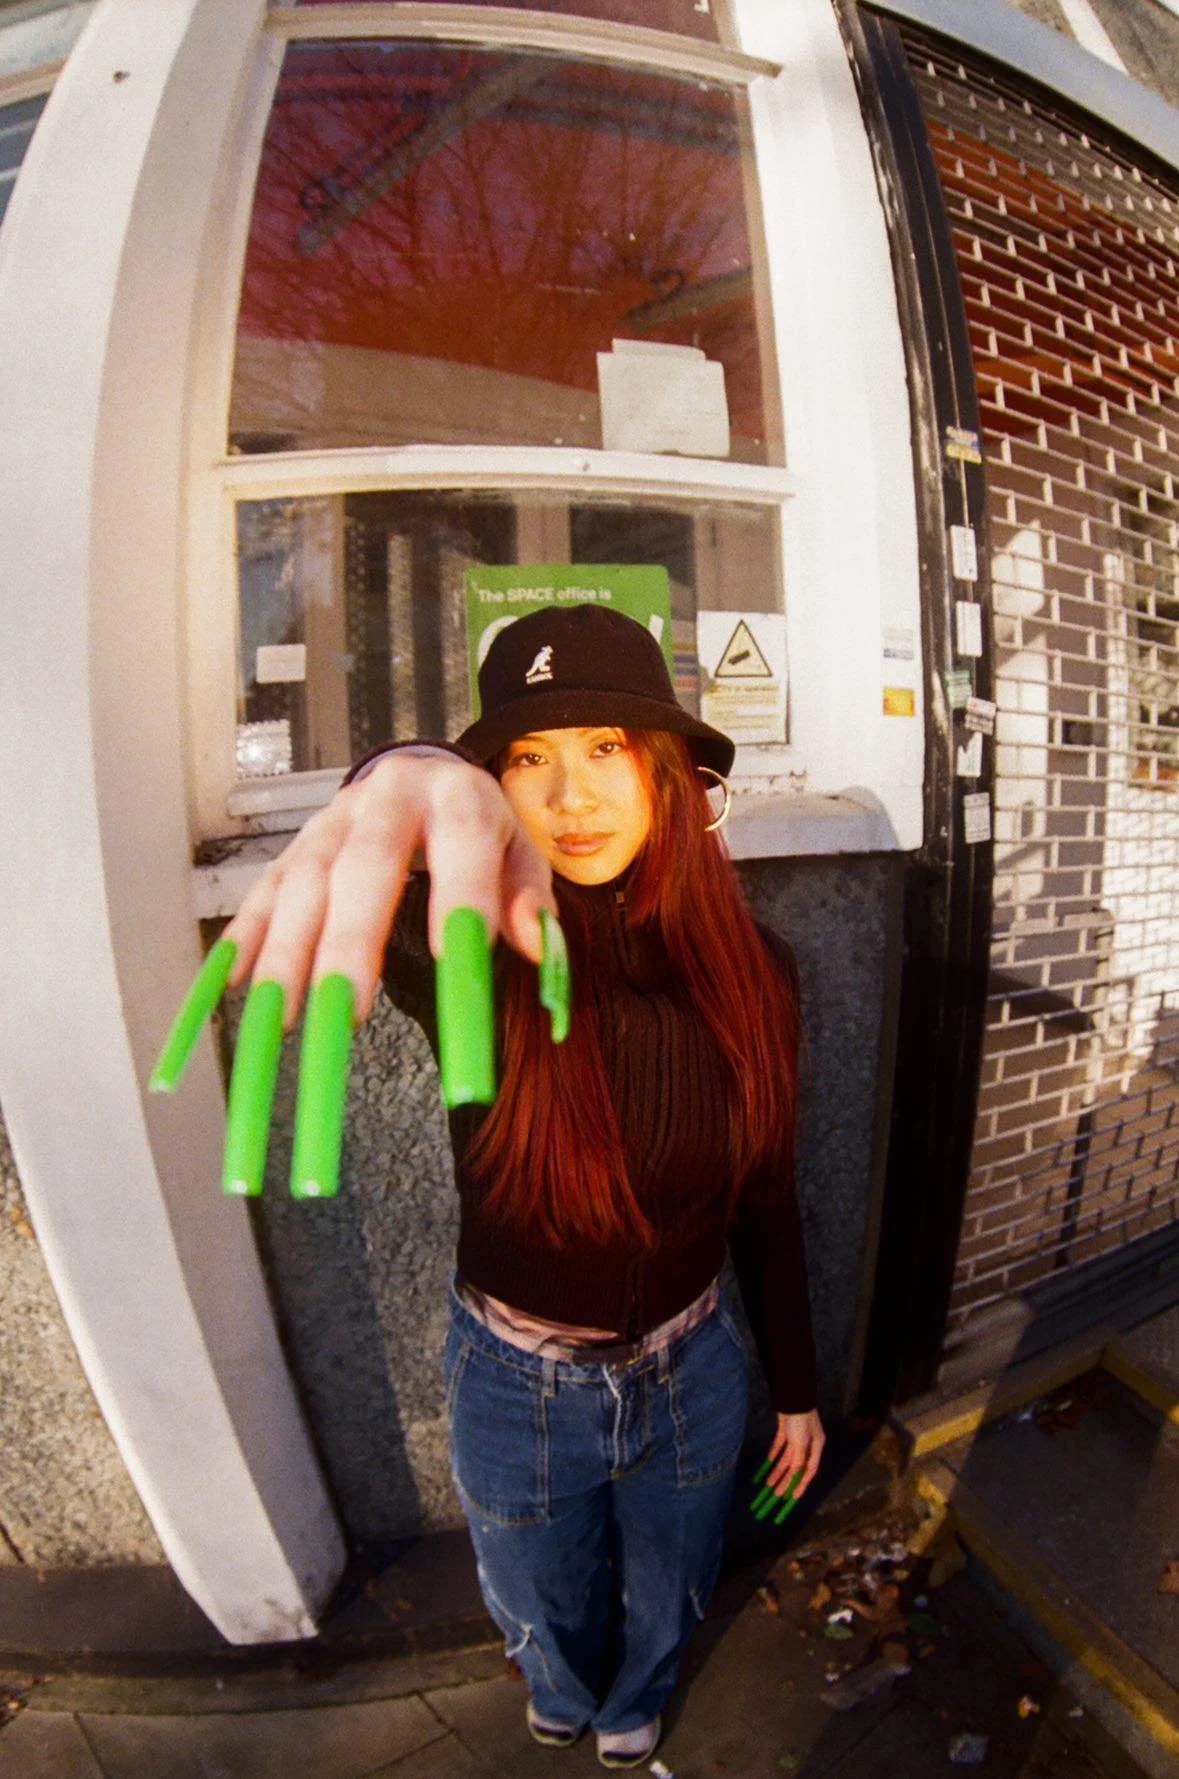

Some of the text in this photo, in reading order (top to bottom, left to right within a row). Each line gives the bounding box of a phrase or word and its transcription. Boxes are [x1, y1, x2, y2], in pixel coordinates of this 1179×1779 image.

[479, 586, 612, 602] The SPACE office is
